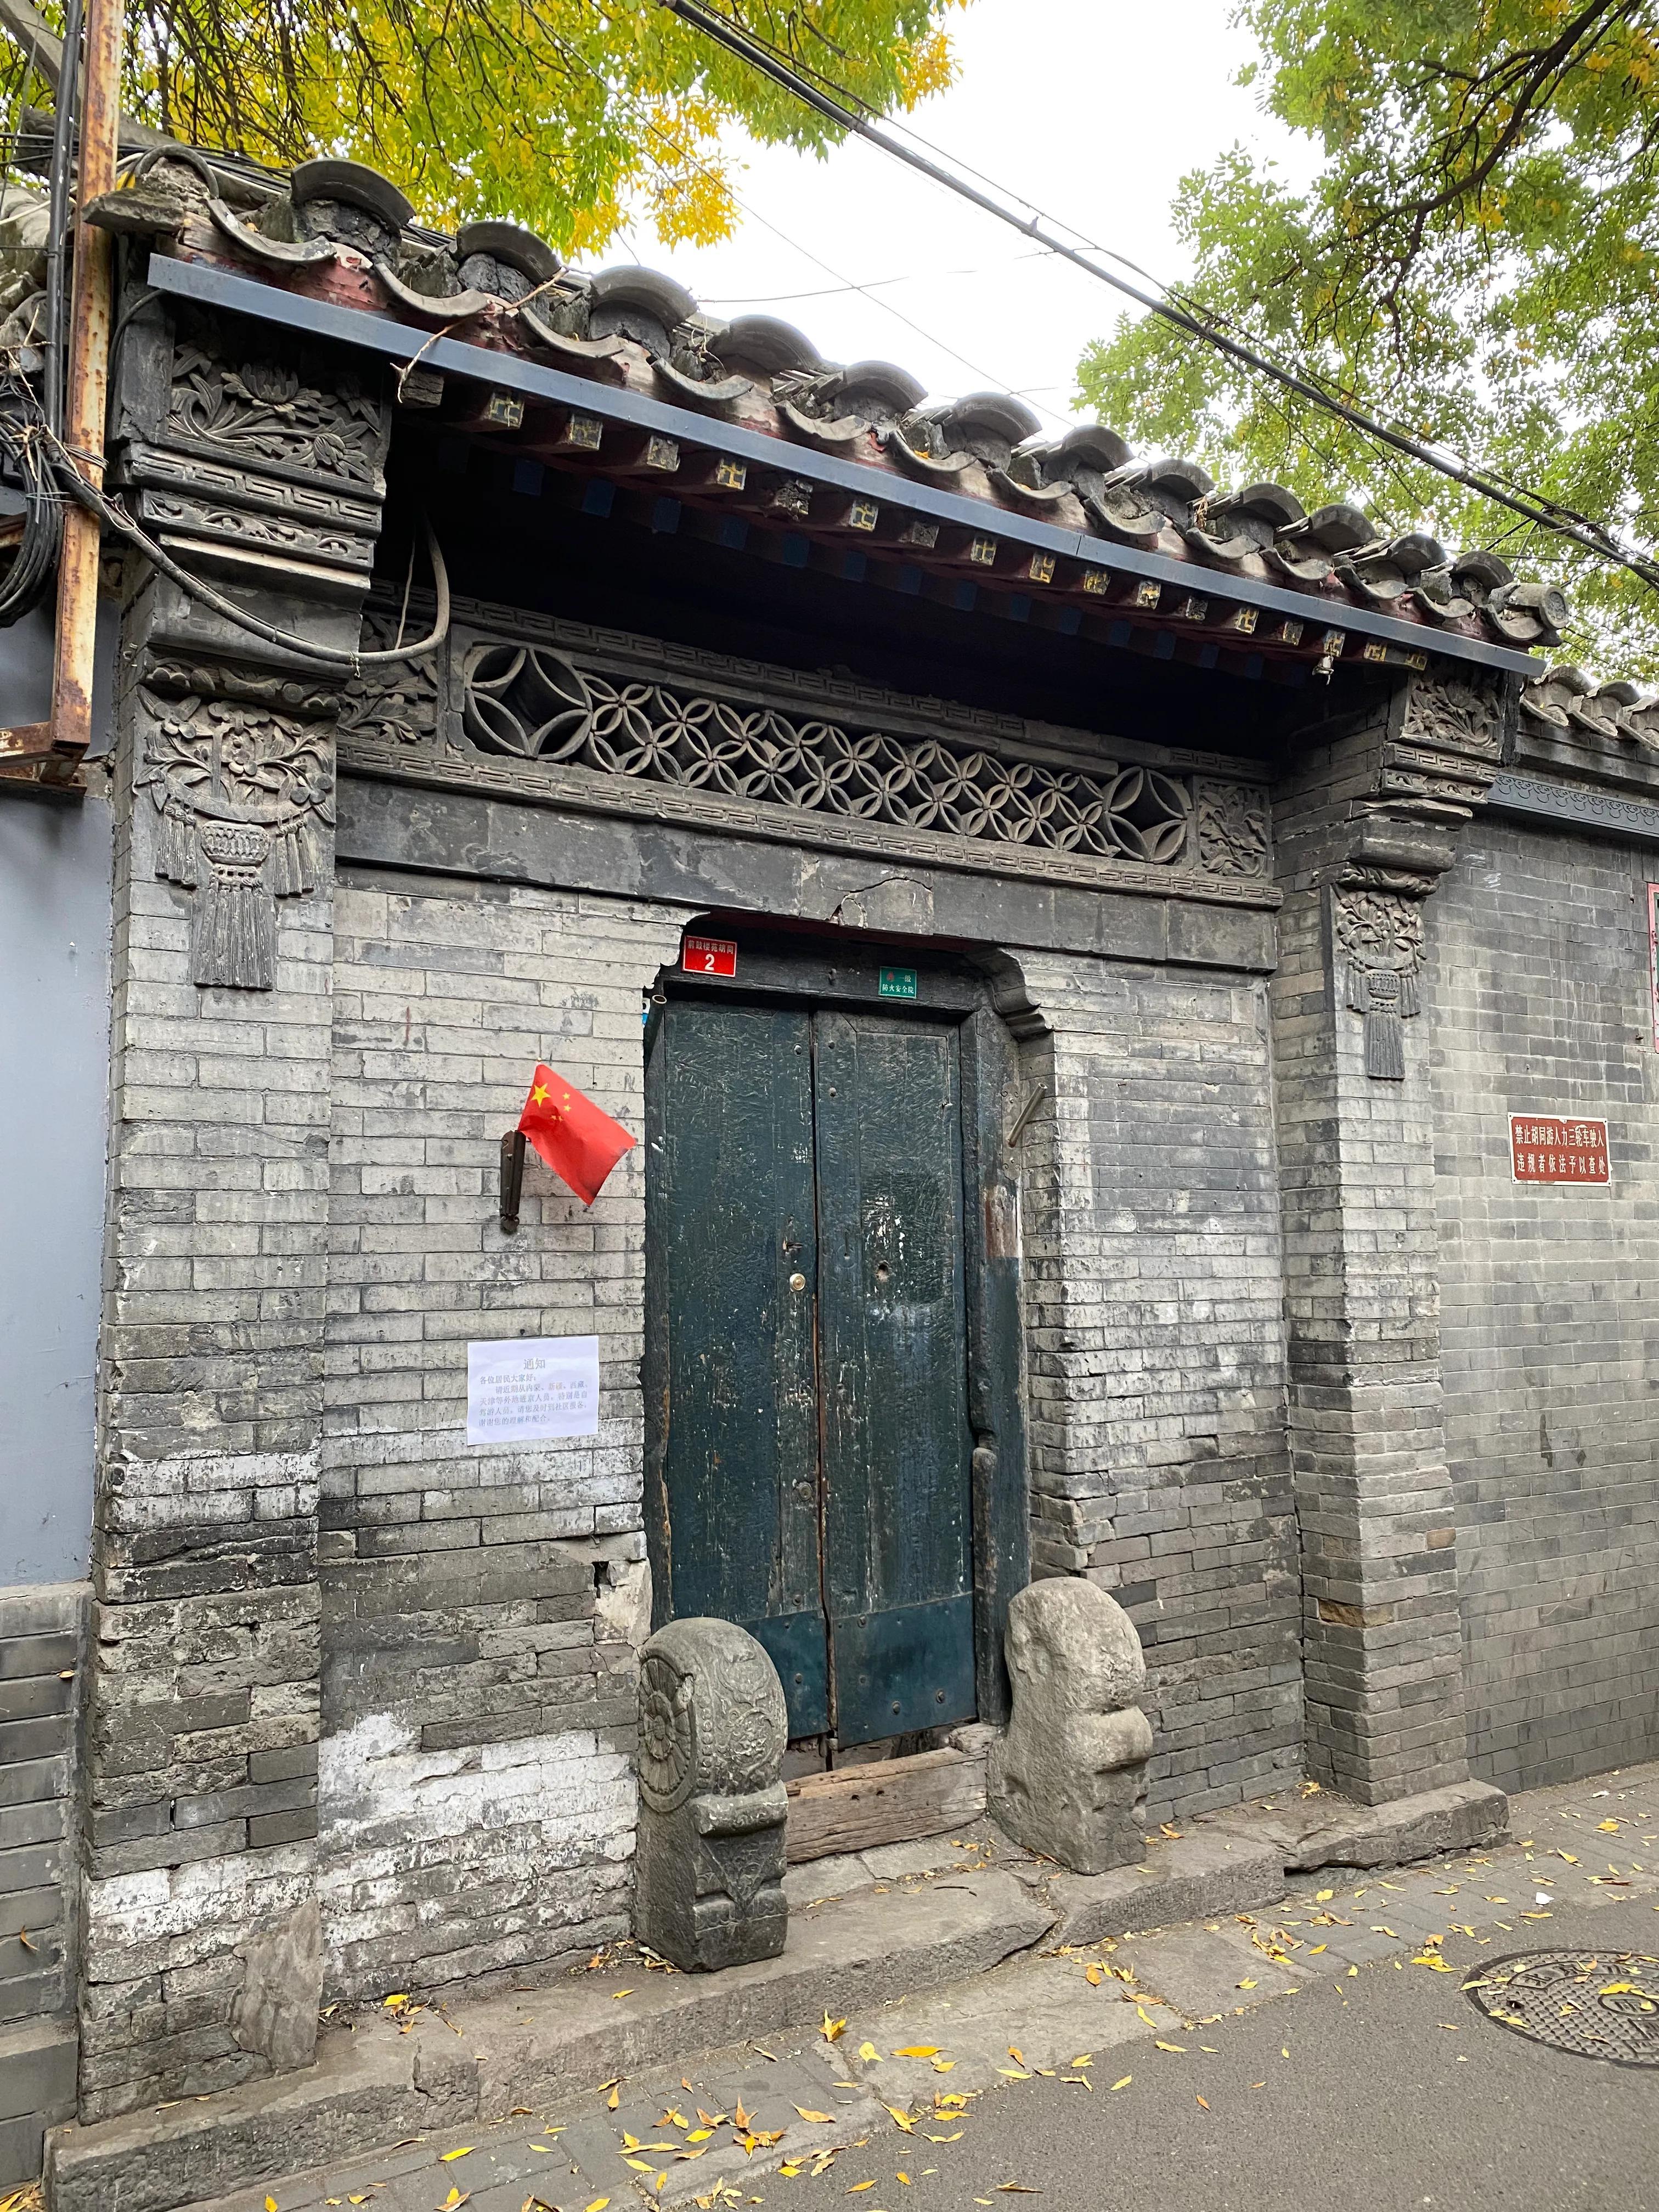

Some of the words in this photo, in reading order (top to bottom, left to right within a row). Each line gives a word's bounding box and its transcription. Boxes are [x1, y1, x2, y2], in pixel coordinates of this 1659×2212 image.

[688, 940, 733, 955] 前鼓楼苑胡同
[704, 953, 715, 971] 2
[899, 974, 911, 983] 一级
[882, 984, 915, 994] 防火安全院
[1515, 1124, 1605, 1148] 禁止胡同游人力三轮车驶入
[1517, 1153, 1606, 1176] 违规者依法予以查处
[523, 1358, 546, 1370] 通知
